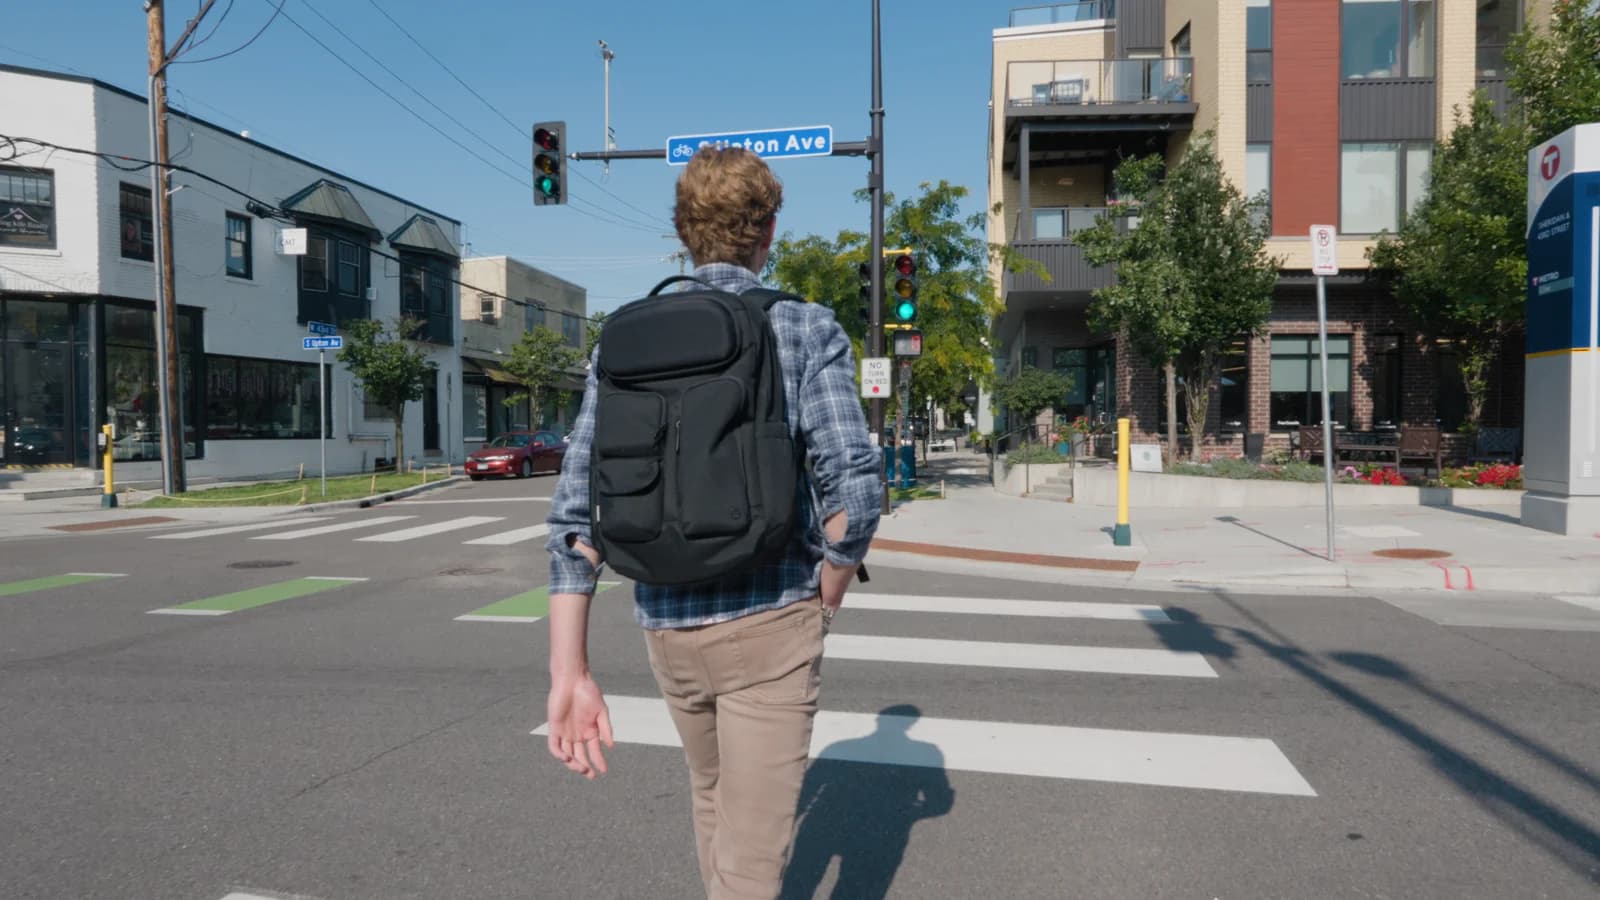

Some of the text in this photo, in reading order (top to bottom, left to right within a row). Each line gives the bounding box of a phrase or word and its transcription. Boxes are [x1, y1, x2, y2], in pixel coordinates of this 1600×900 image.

[785, 134, 826, 152] Ave
[1551, 222, 1570, 236] STREET
[1539, 271, 1559, 283] METRO
